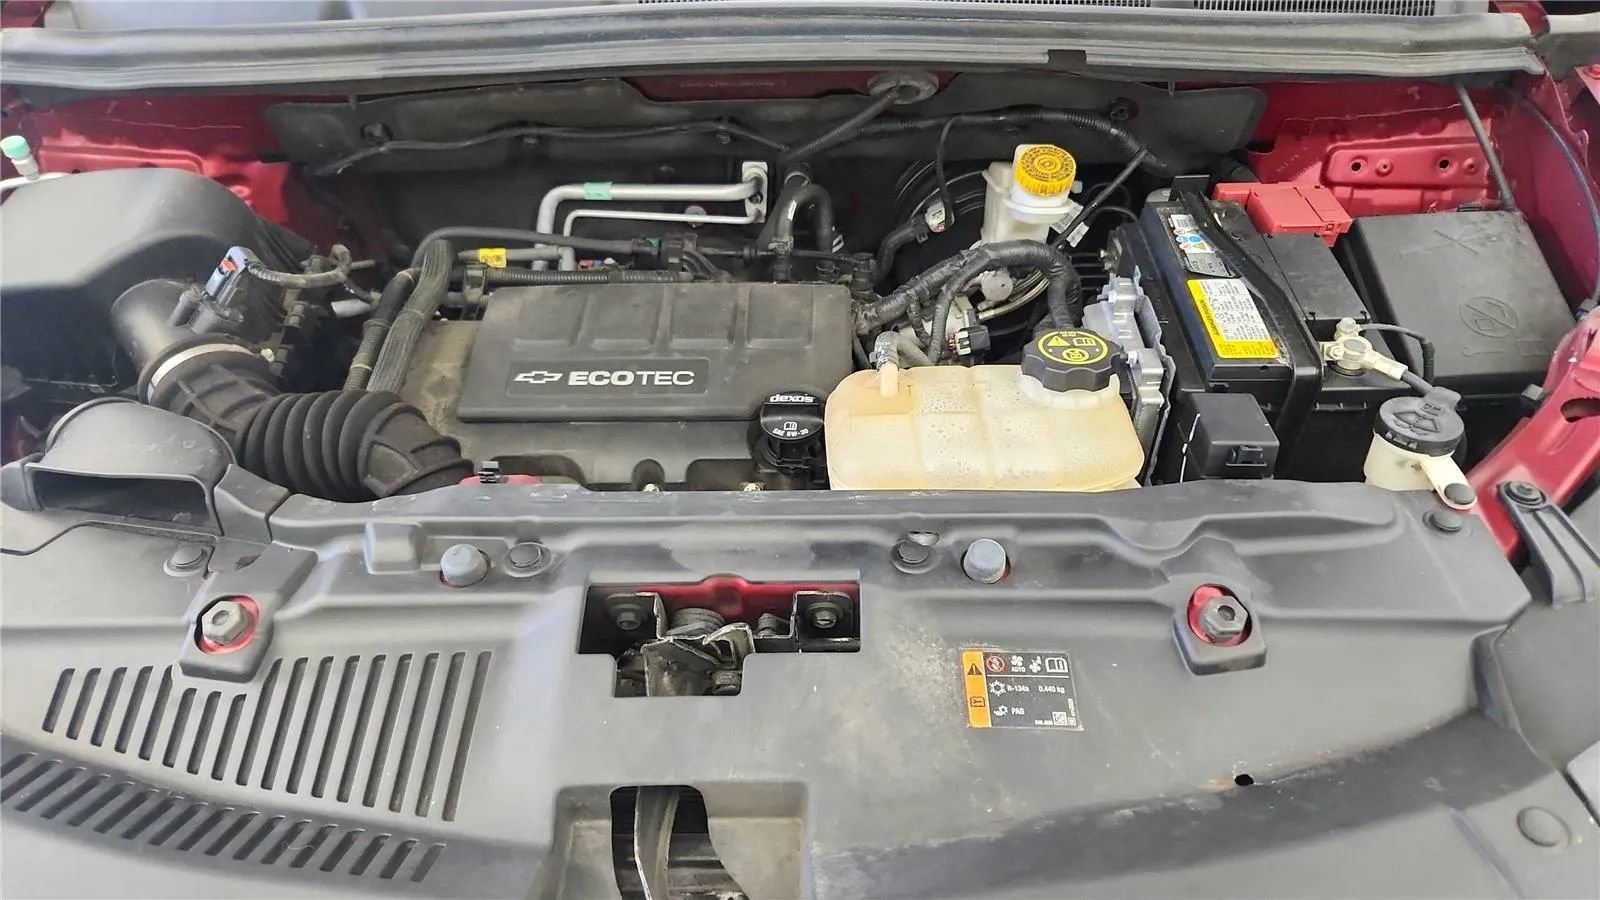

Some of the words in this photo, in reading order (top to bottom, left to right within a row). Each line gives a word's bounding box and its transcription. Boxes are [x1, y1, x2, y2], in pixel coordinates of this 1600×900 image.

[567, 370, 695, 386] ECOTEC
[769, 393, 816, 403] dexos
[1011, 707, 1025, 715] PAG
